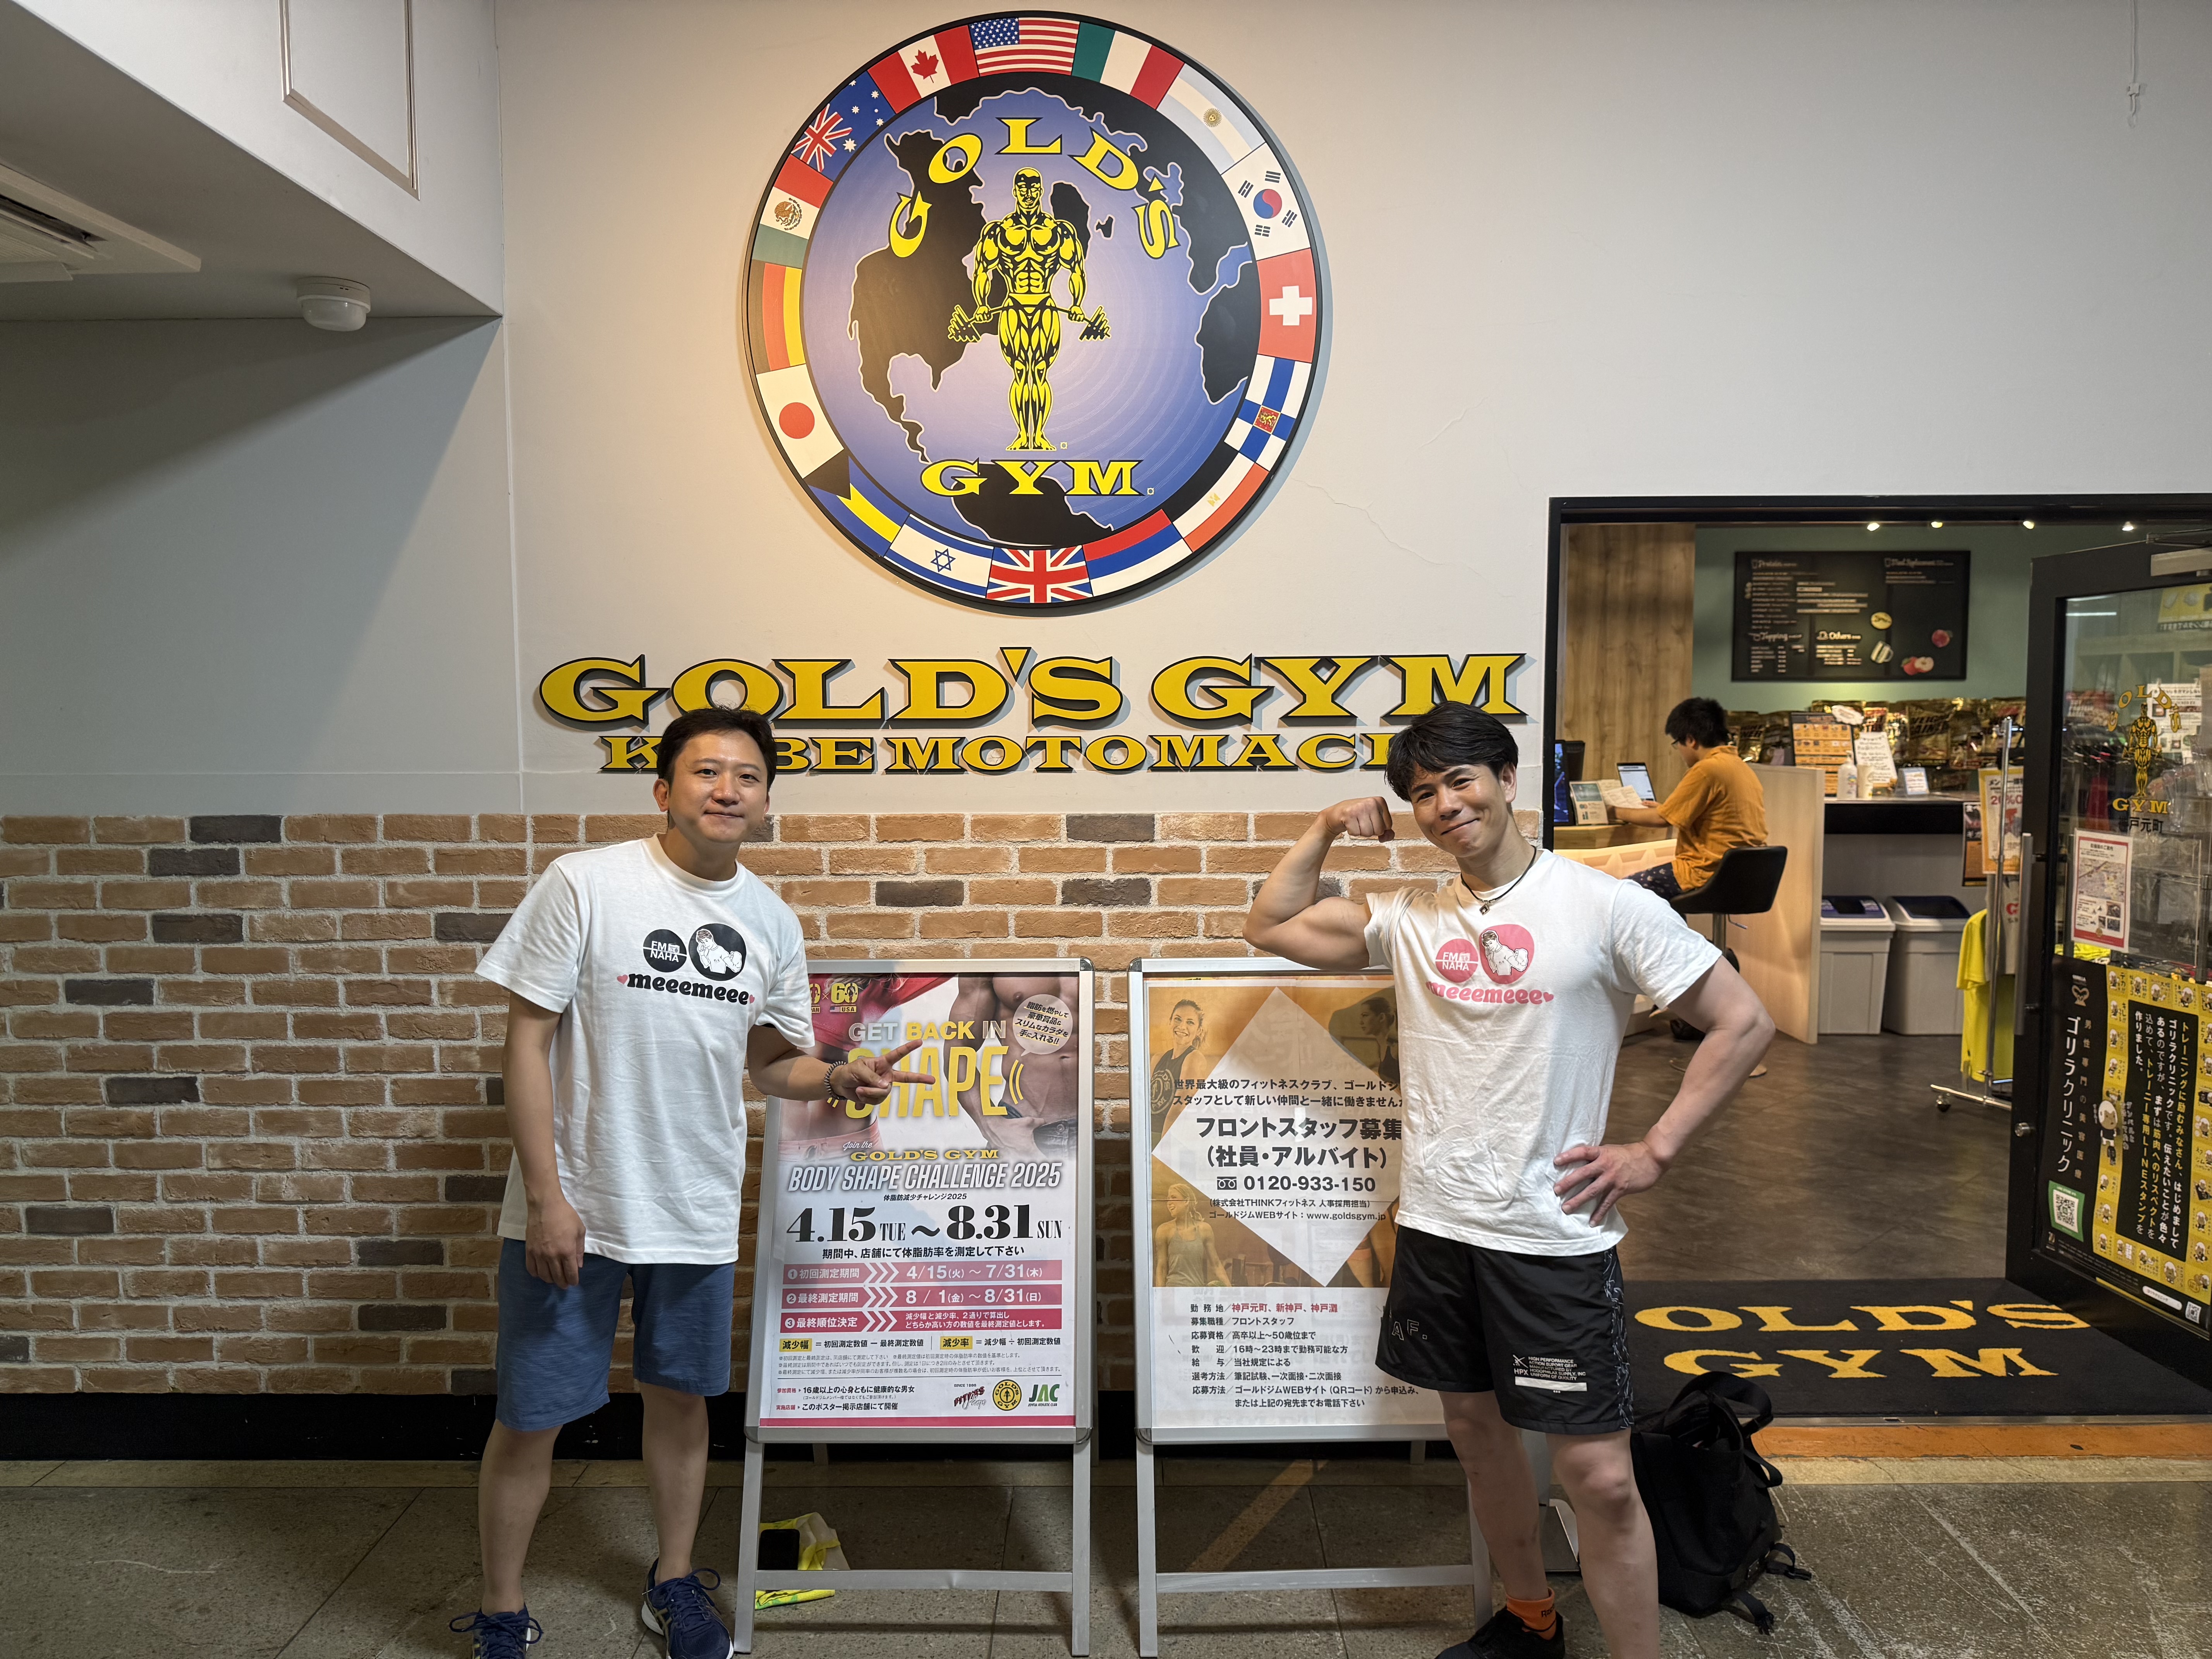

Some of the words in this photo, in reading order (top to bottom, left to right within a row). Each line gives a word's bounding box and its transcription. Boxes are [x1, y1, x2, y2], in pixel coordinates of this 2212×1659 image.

[888, 117, 1180, 260] GOLD'S
[921, 457, 1142, 497] GYM
[539, 647, 1122, 725] GOLD'S
[1151, 652, 1527, 720] GYM
[2108, 685, 2182, 733] GOLD'S
[2112, 798, 2168, 814] GYM
[651, 940, 667, 951] FM
[650, 950, 680, 963] NAHA
[1443, 951, 1458, 960] FM
[1442, 962, 1470, 971] NAHA
[627, 973, 749, 1005] meeemeee
[1427, 981, 1543, 1005] meeemeee
[1026, 1001, 1069, 1018] 脂肪を燃やして
[848, 1022, 898, 1041] GET
[906, 1020, 975, 1040] BACK
[982, 1020, 1006, 1039] IN
[1015, 1018, 1069, 1037] スリムなカラダを
[2135, 1010, 2143, 1072] 作りました。
[2057, 1016, 2081, 1172] ゴリラクリニック
[1196, 1116, 1401, 1141] フロントスタッフ募集
[843, 1141, 860, 1151] Join
[850, 1149, 938, 1162] GOLD'S
[945, 1149, 1000, 1160] GYM
[788, 1166, 839, 1192] BODY
[842, 1164, 902, 1190] SHAPE
[905, 1163, 1009, 1189] CHALLENGE
[1011, 1162, 1063, 1188] 2025
[1243, 1175, 1376, 1192] 0120-933-150
[883, 1193, 967, 1202] 体脂肪減少チャレンジ2025
[787, 1206, 876, 1242] 4.15
[879, 1222, 906, 1241] TUE
[946, 1204, 1033, 1240] 8.31
[1037, 1220, 1063, 1239] SUN
[822, 1245, 1025, 1260] 期間中、店舗にて体脂肪率を測定して下さい
[1634, 1300, 2092, 1333] OLD'S
[782, 1340, 809, 1350] 減少幅
[943, 1338, 969, 1347] 減少率
[1663, 1347, 2060, 1379] GYM
[995, 1382, 1020, 1396] GOLD'S
[1029, 1384, 1060, 1402] JAC
[997, 1399, 1018, 1408] GYM
[1235, 1398, 1365, 1408] または上記の宛先までお電話下さい
